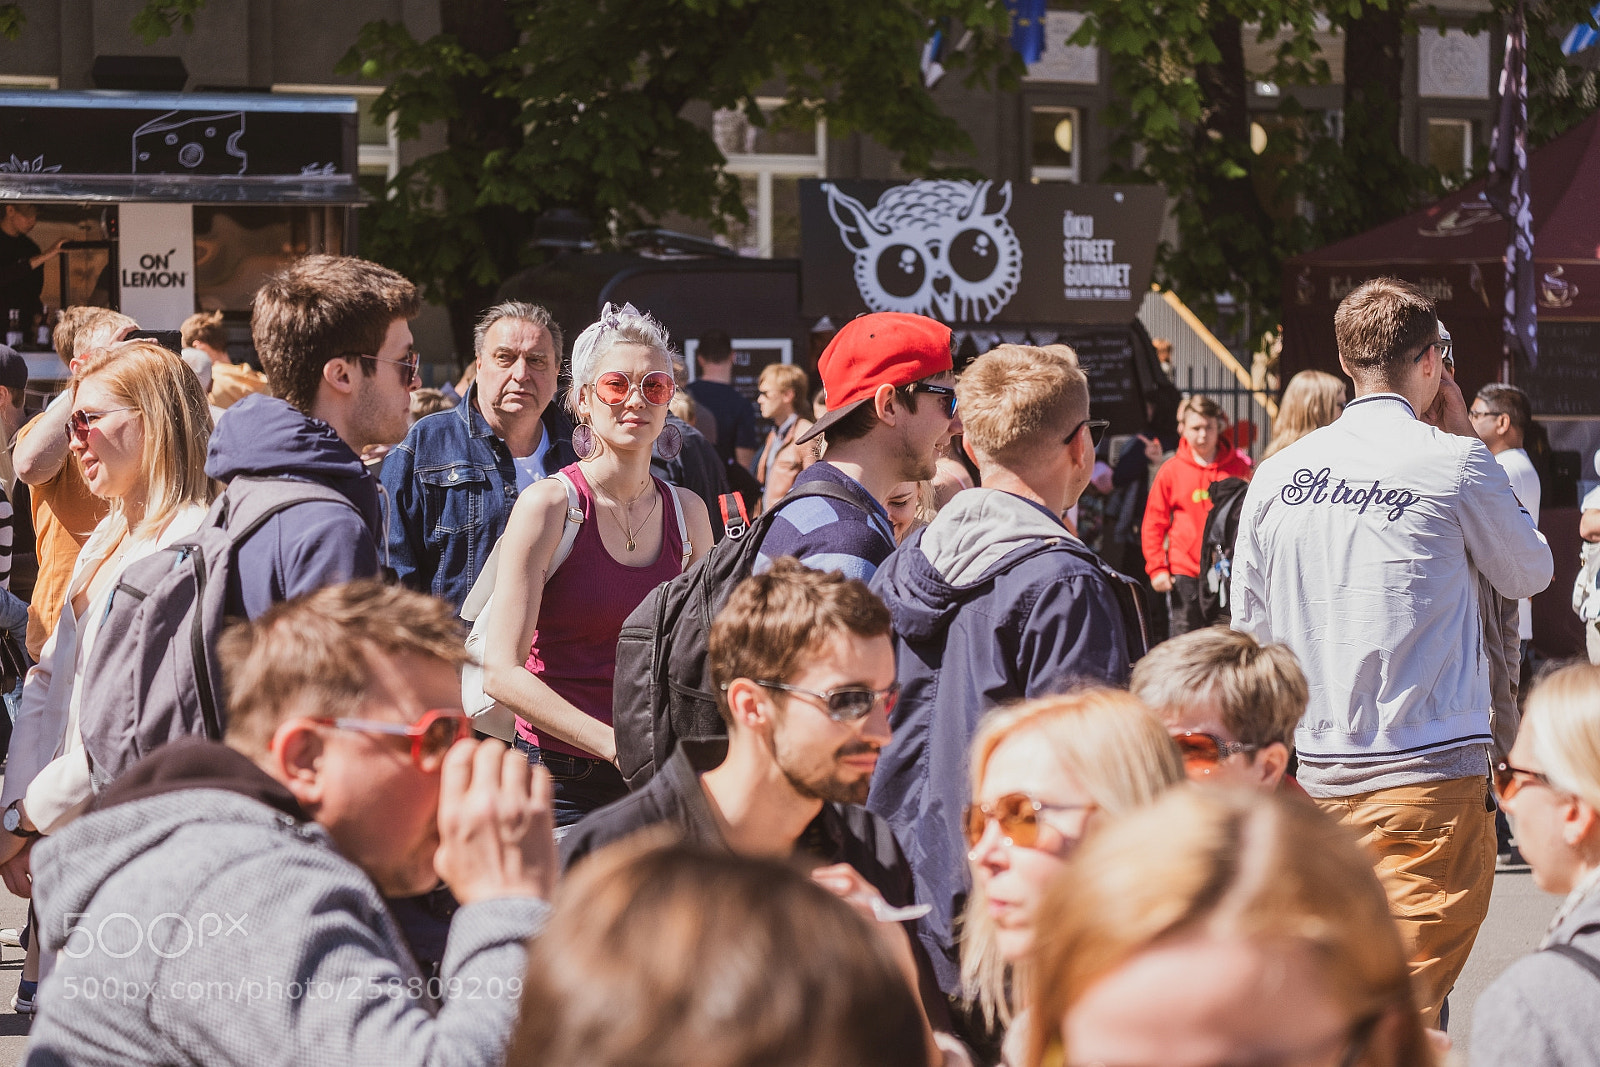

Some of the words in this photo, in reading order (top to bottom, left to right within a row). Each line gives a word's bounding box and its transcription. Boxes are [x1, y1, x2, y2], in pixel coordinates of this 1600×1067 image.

[140, 253, 169, 270] ON
[1063, 239, 1116, 262] STREET
[122, 268, 186, 288] LEMON
[1063, 262, 1132, 287] GOURMET
[1281, 467, 1331, 506] St
[1330, 478, 1421, 522] tropez
